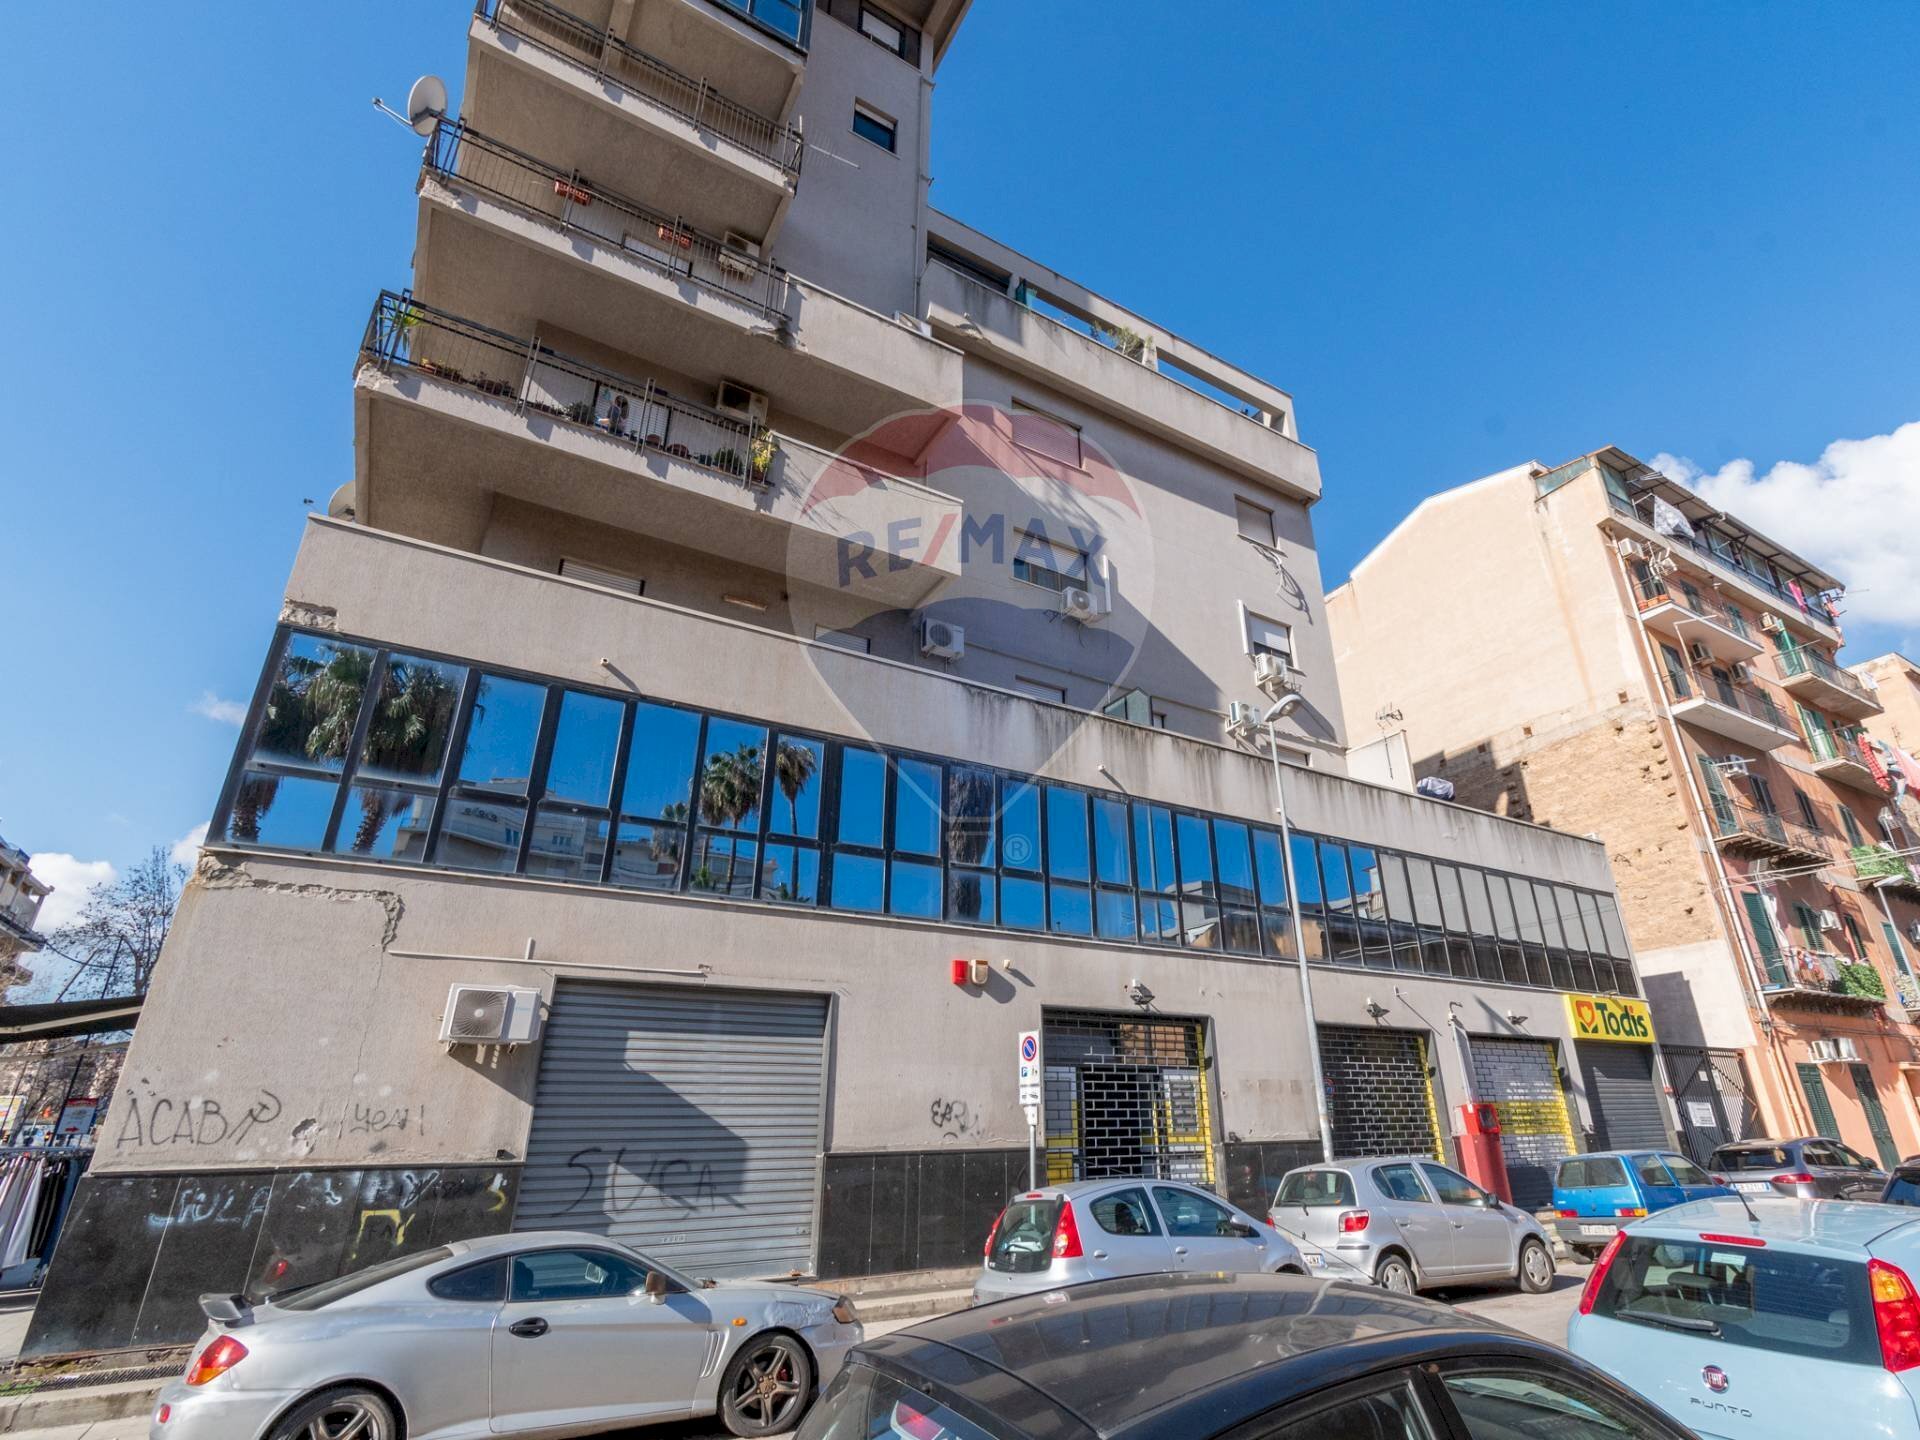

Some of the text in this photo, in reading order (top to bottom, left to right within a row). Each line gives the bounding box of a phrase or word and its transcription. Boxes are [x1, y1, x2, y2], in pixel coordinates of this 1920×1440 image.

[1594, 1002, 1649, 1037] Todis
[116, 1098, 228, 1148] ACAB
[551, 1147, 746, 1220] SUCA
[1689, 1397, 1753, 1418] PUNTO
